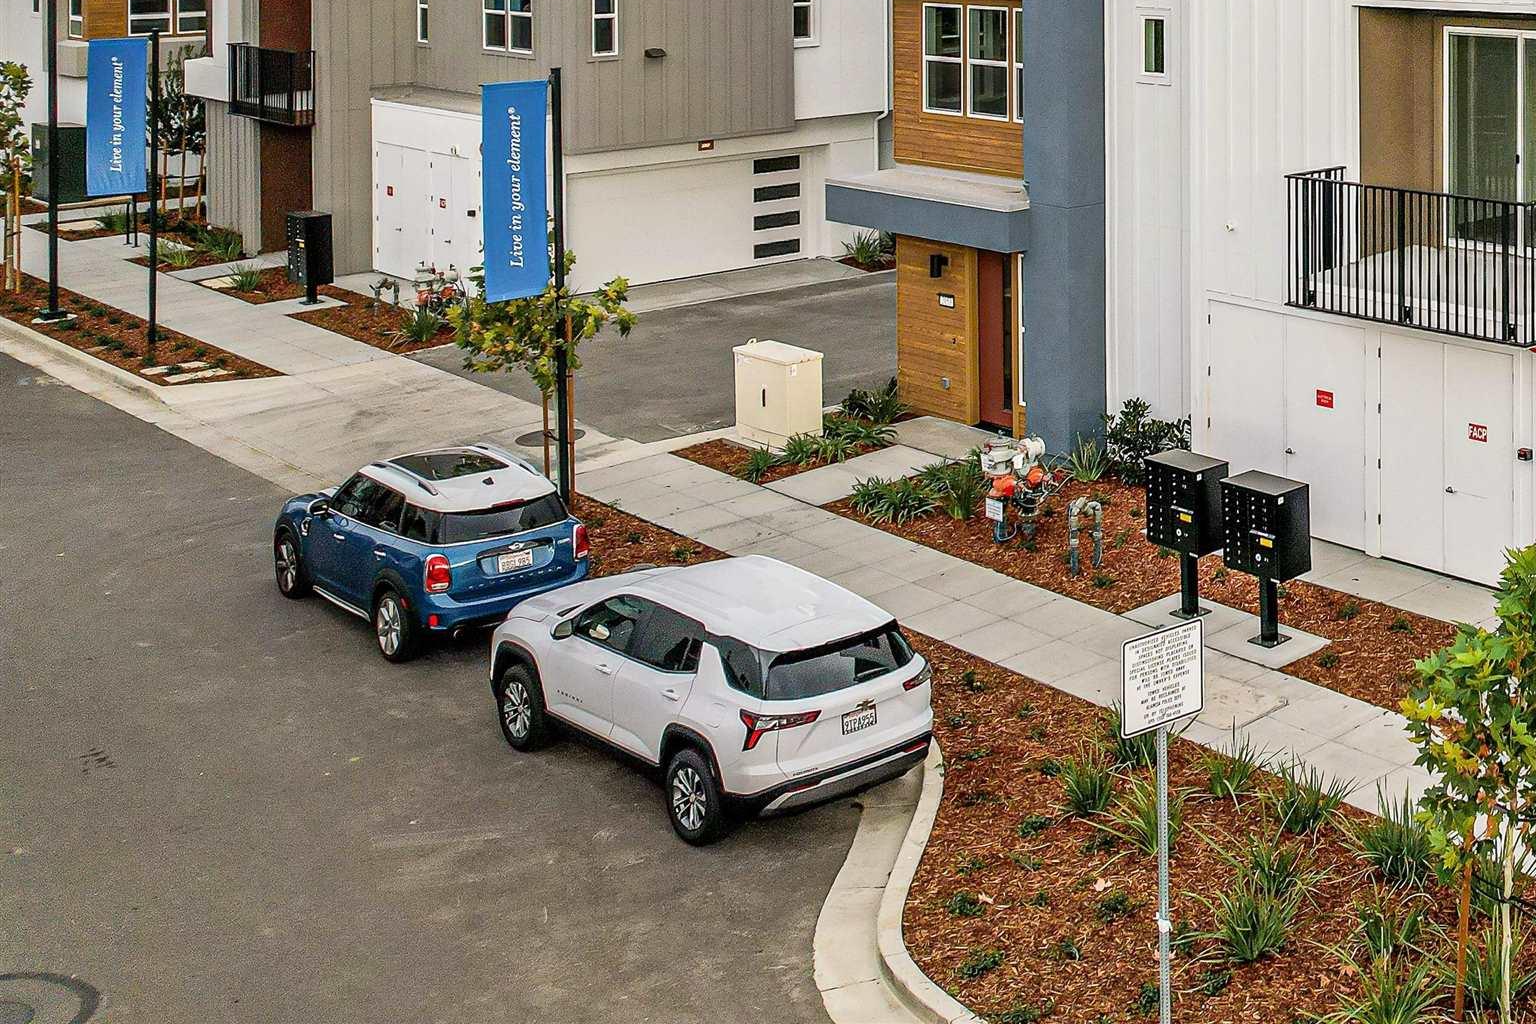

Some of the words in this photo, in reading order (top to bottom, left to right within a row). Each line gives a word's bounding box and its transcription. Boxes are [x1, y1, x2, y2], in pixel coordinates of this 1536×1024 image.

[112, 106, 125, 132] your
[110, 132, 121, 145] in
[110, 147, 122, 173] Live
[511, 175, 525, 211] your
[509, 215, 522, 231] in
[509, 233, 524, 268] Live
[1468, 426, 1487, 440] FACP
